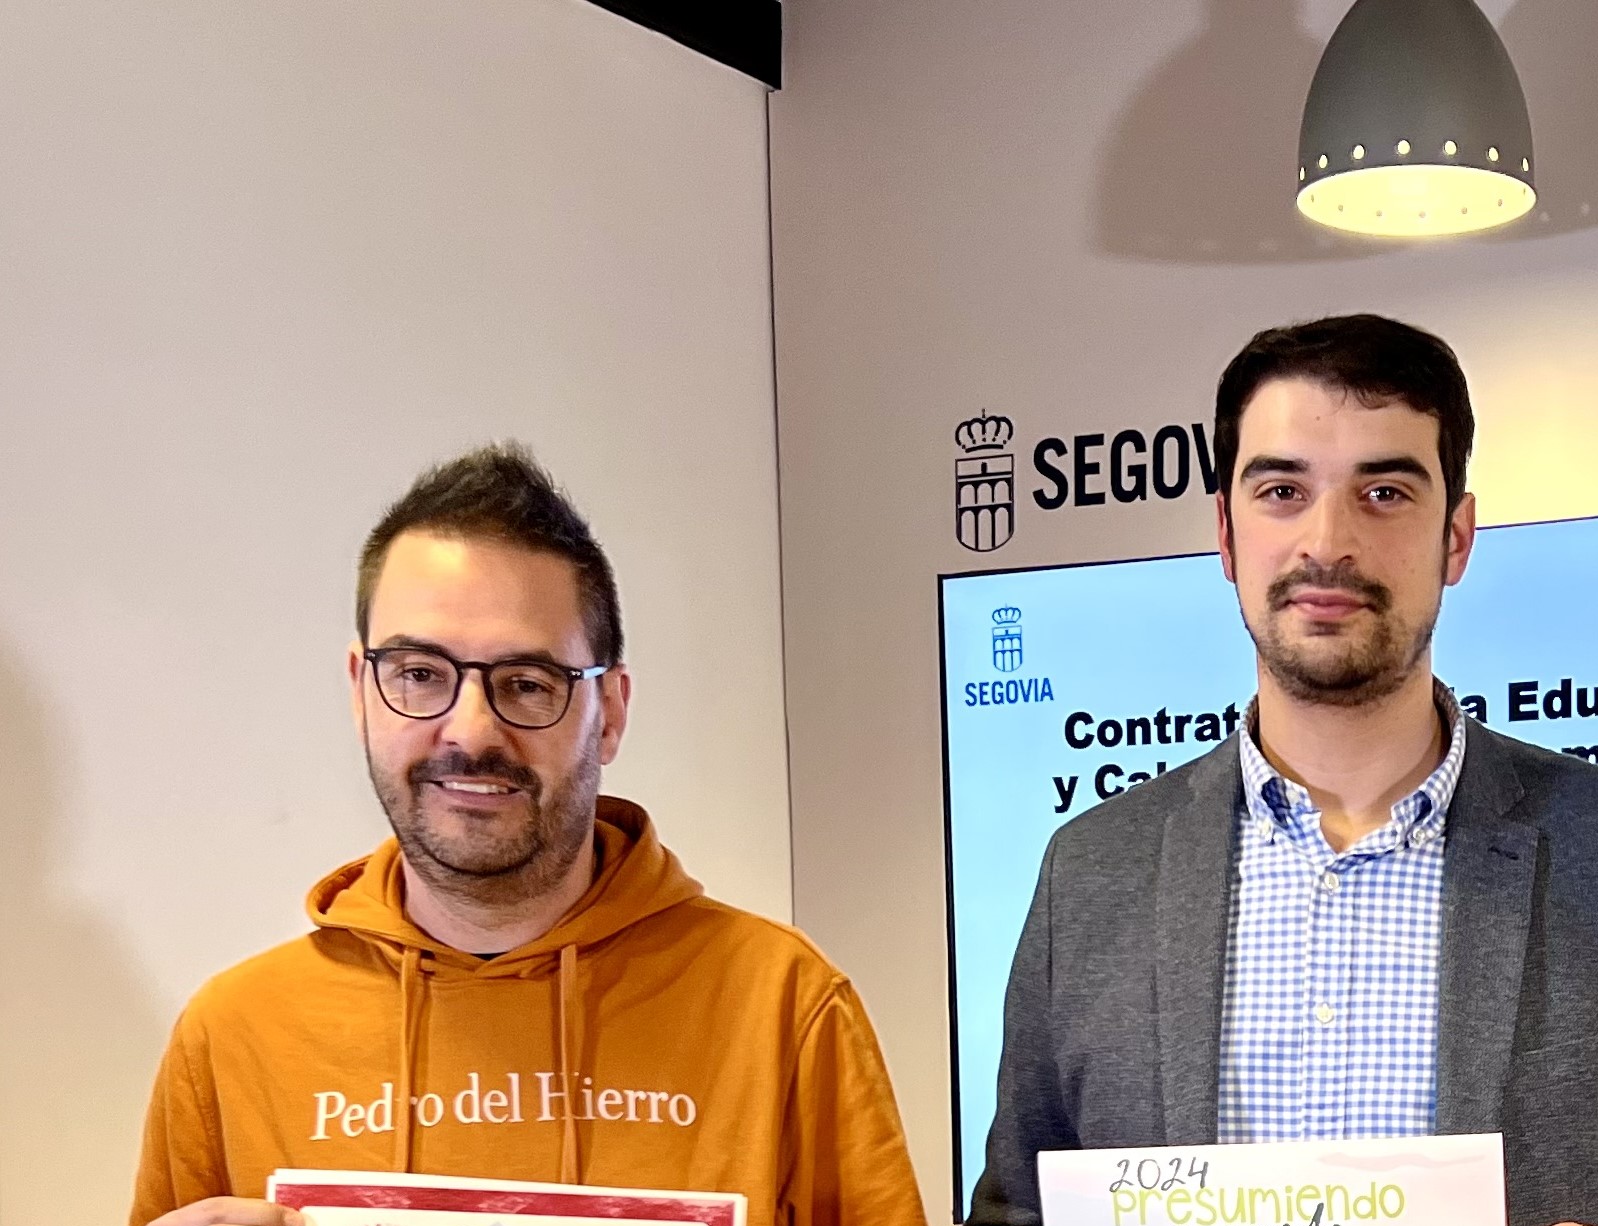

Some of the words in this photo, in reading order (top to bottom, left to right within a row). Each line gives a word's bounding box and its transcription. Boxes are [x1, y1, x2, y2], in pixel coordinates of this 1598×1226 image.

[1032, 422, 1217, 510] SEGOV
[965, 677, 1055, 707] SEGOVIA
[1064, 702, 1241, 749] Contrat
[1052, 775, 1079, 813] y
[453, 1071, 525, 1124] del
[1109, 1156, 1210, 1193] 2024
